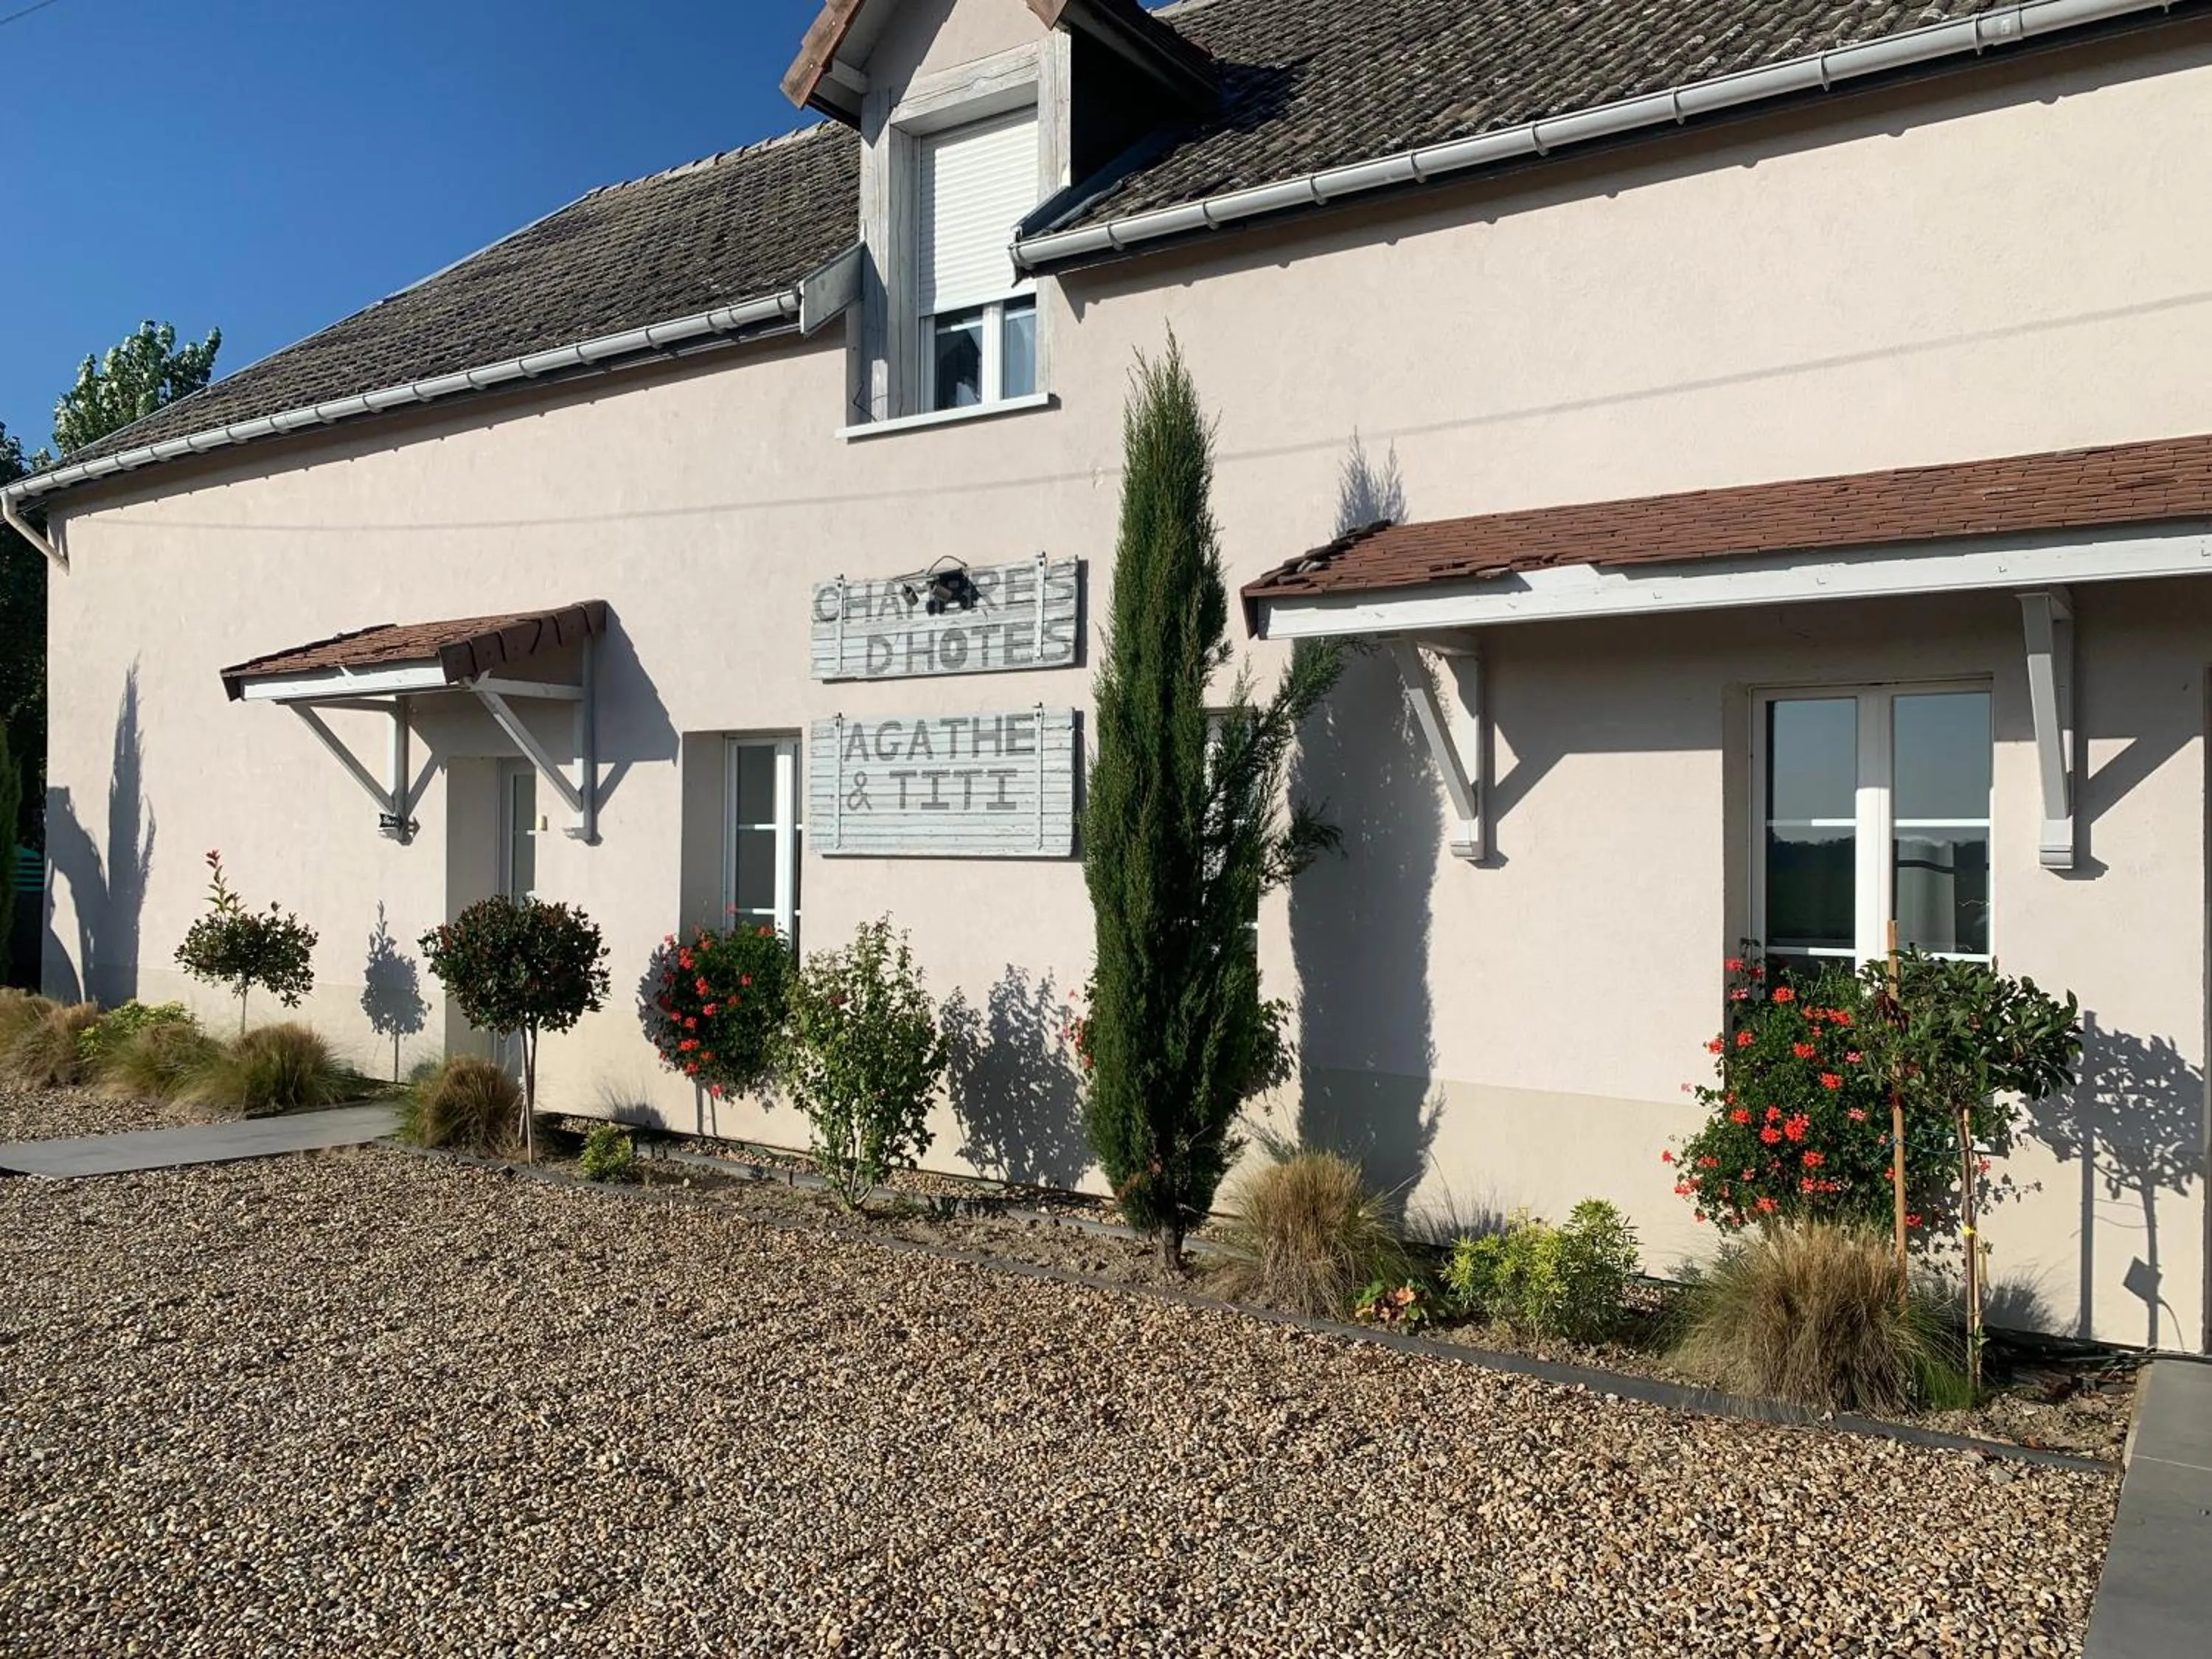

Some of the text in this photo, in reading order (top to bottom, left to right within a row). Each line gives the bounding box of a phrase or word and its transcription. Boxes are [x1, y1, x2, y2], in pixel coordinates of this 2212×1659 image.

[814, 565, 1074, 622] CHARES
[865, 621, 1072, 674] D'HOTES
[844, 713, 1035, 762] AGATHE
[846, 768, 1018, 811] & TITI
